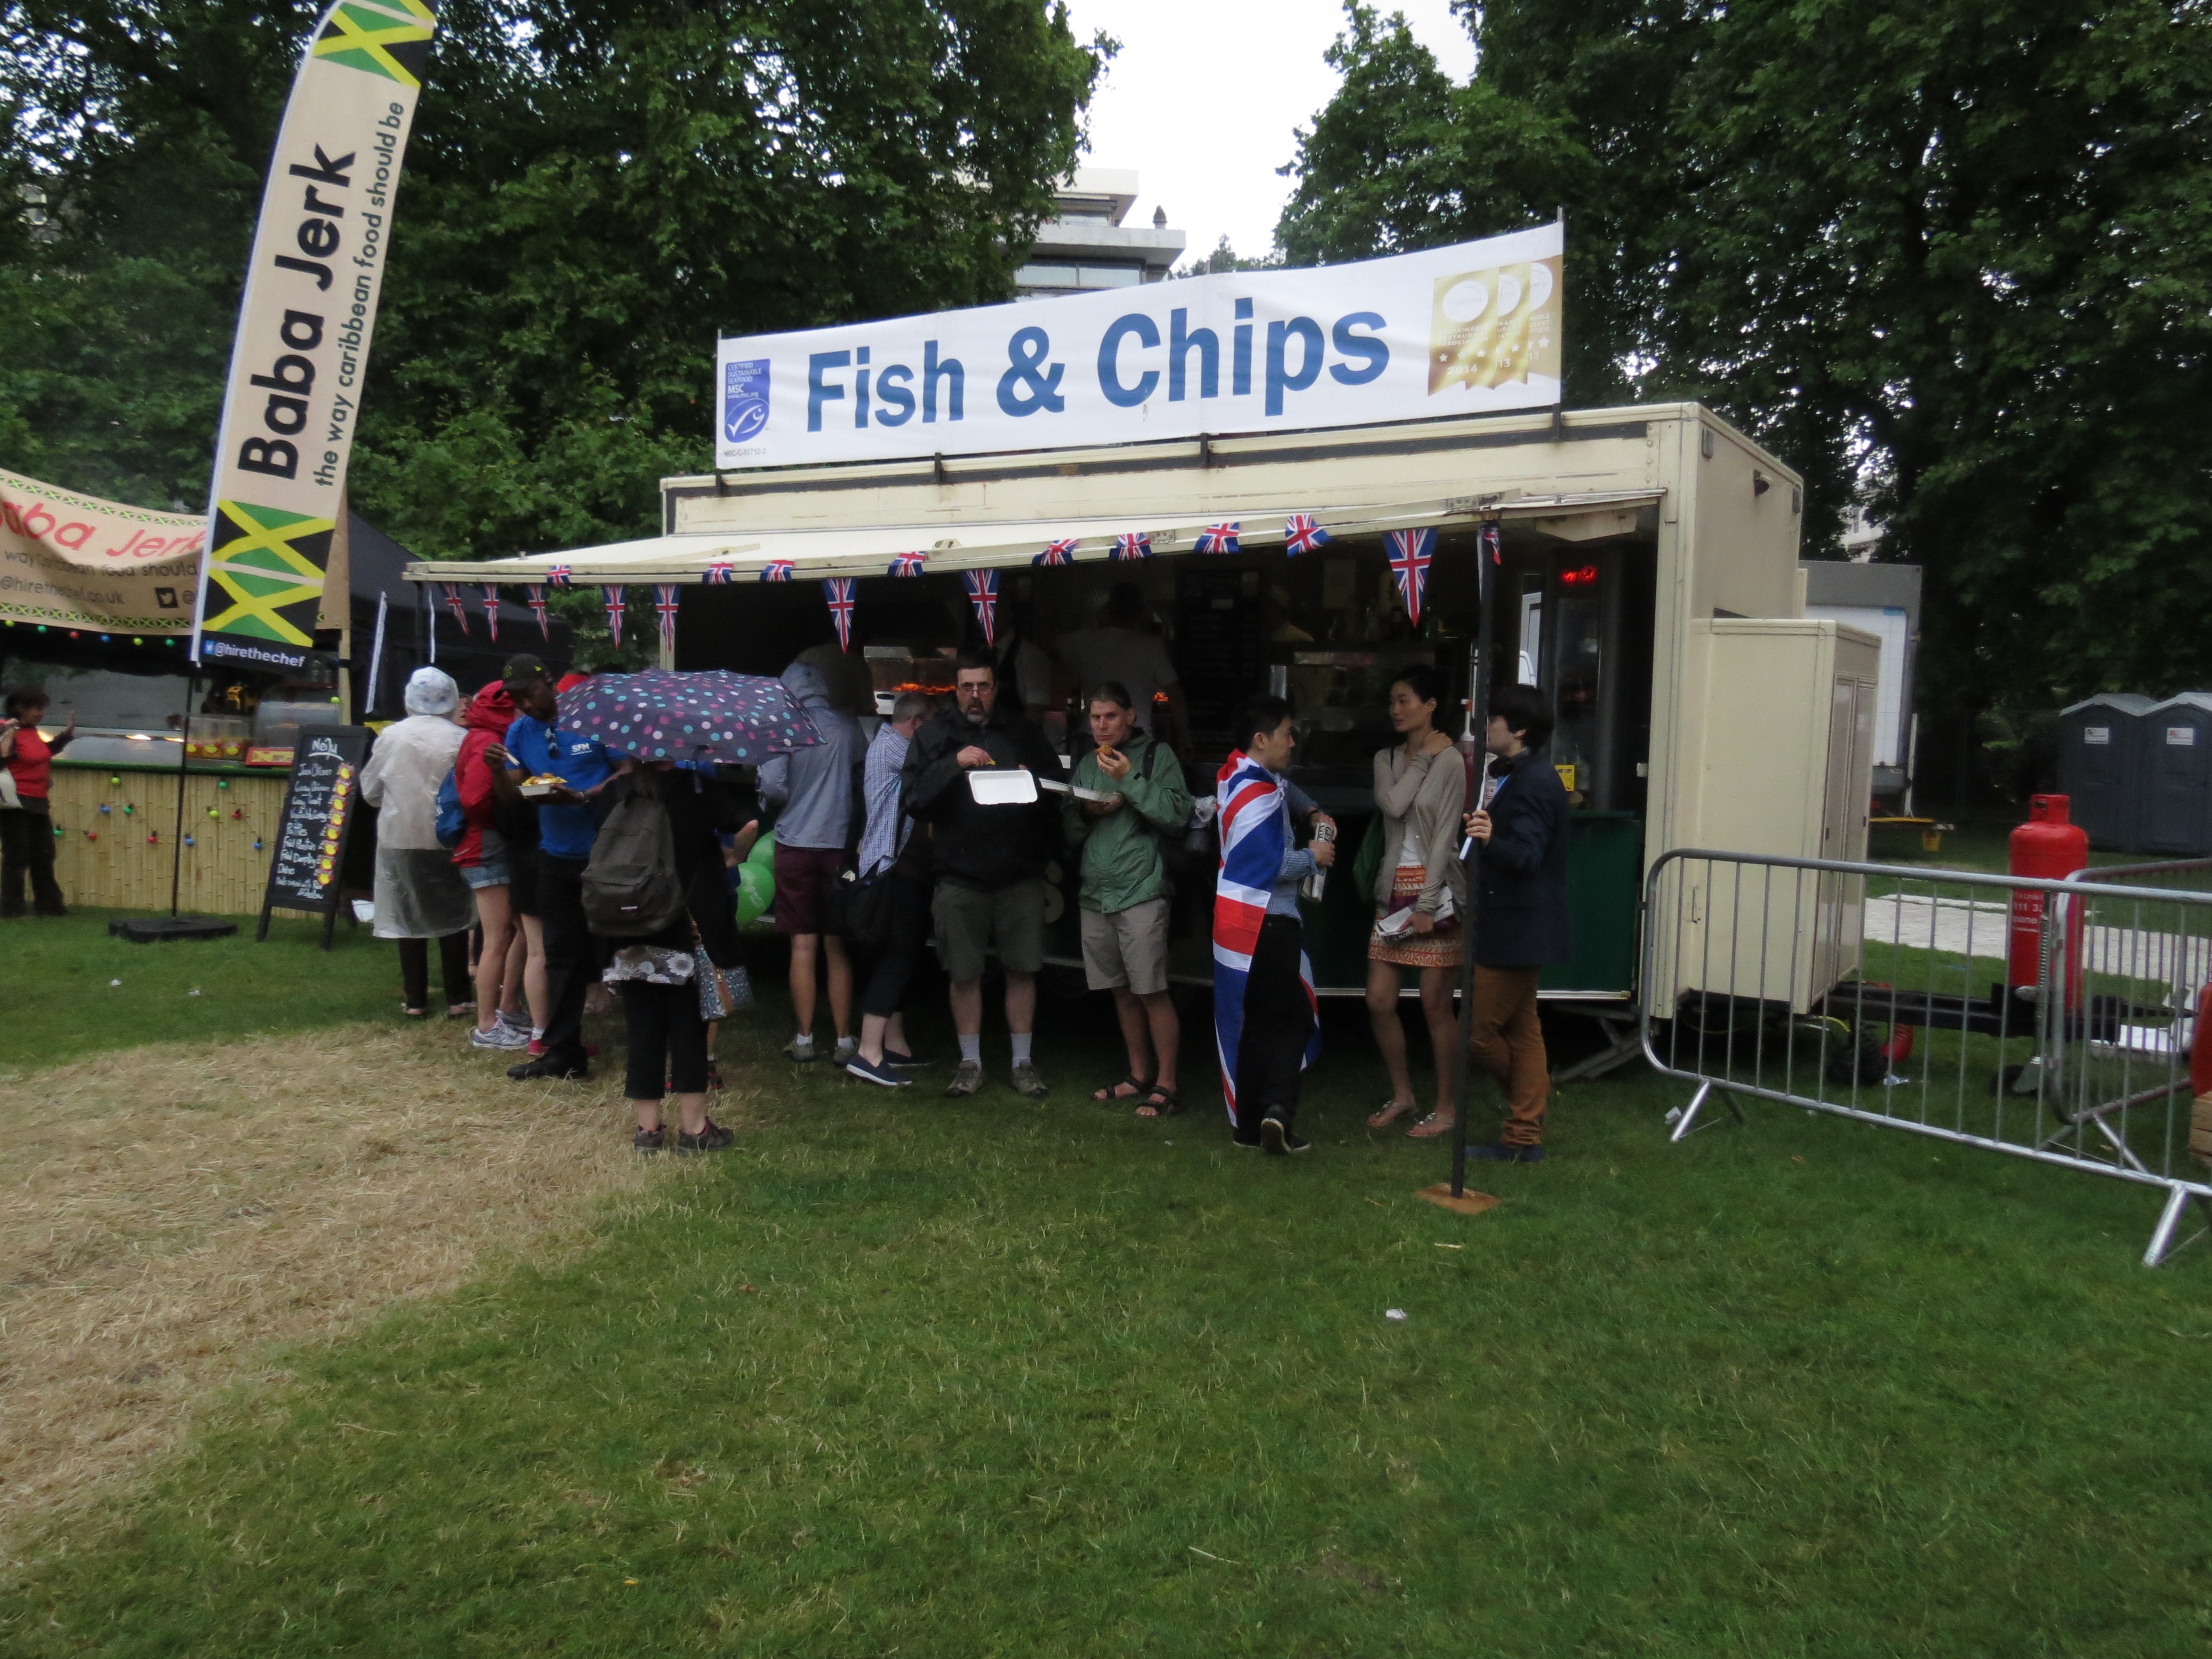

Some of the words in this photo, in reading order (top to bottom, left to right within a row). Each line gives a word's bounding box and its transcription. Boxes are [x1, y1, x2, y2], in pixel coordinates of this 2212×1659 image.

[378, 102, 405, 131] be
[366, 133, 397, 207] should
[274, 142, 356, 292] Jerk
[353, 212, 382, 269] food
[337, 273, 373, 388] caribbean
[728, 384, 745, 394] MSC
[808, 341, 964, 431] Fish
[997, 327, 1065, 416] &
[1098, 298, 1390, 416] Chips
[1447, 363, 1478, 376] 2014
[237, 309, 325, 480] Baba
[327, 393, 354, 445] way
[313, 452, 338, 487] the
[0, 501, 96, 551] aba
[214, 641, 306, 669] @hirethechef
[571, 743, 590, 753] SFM
